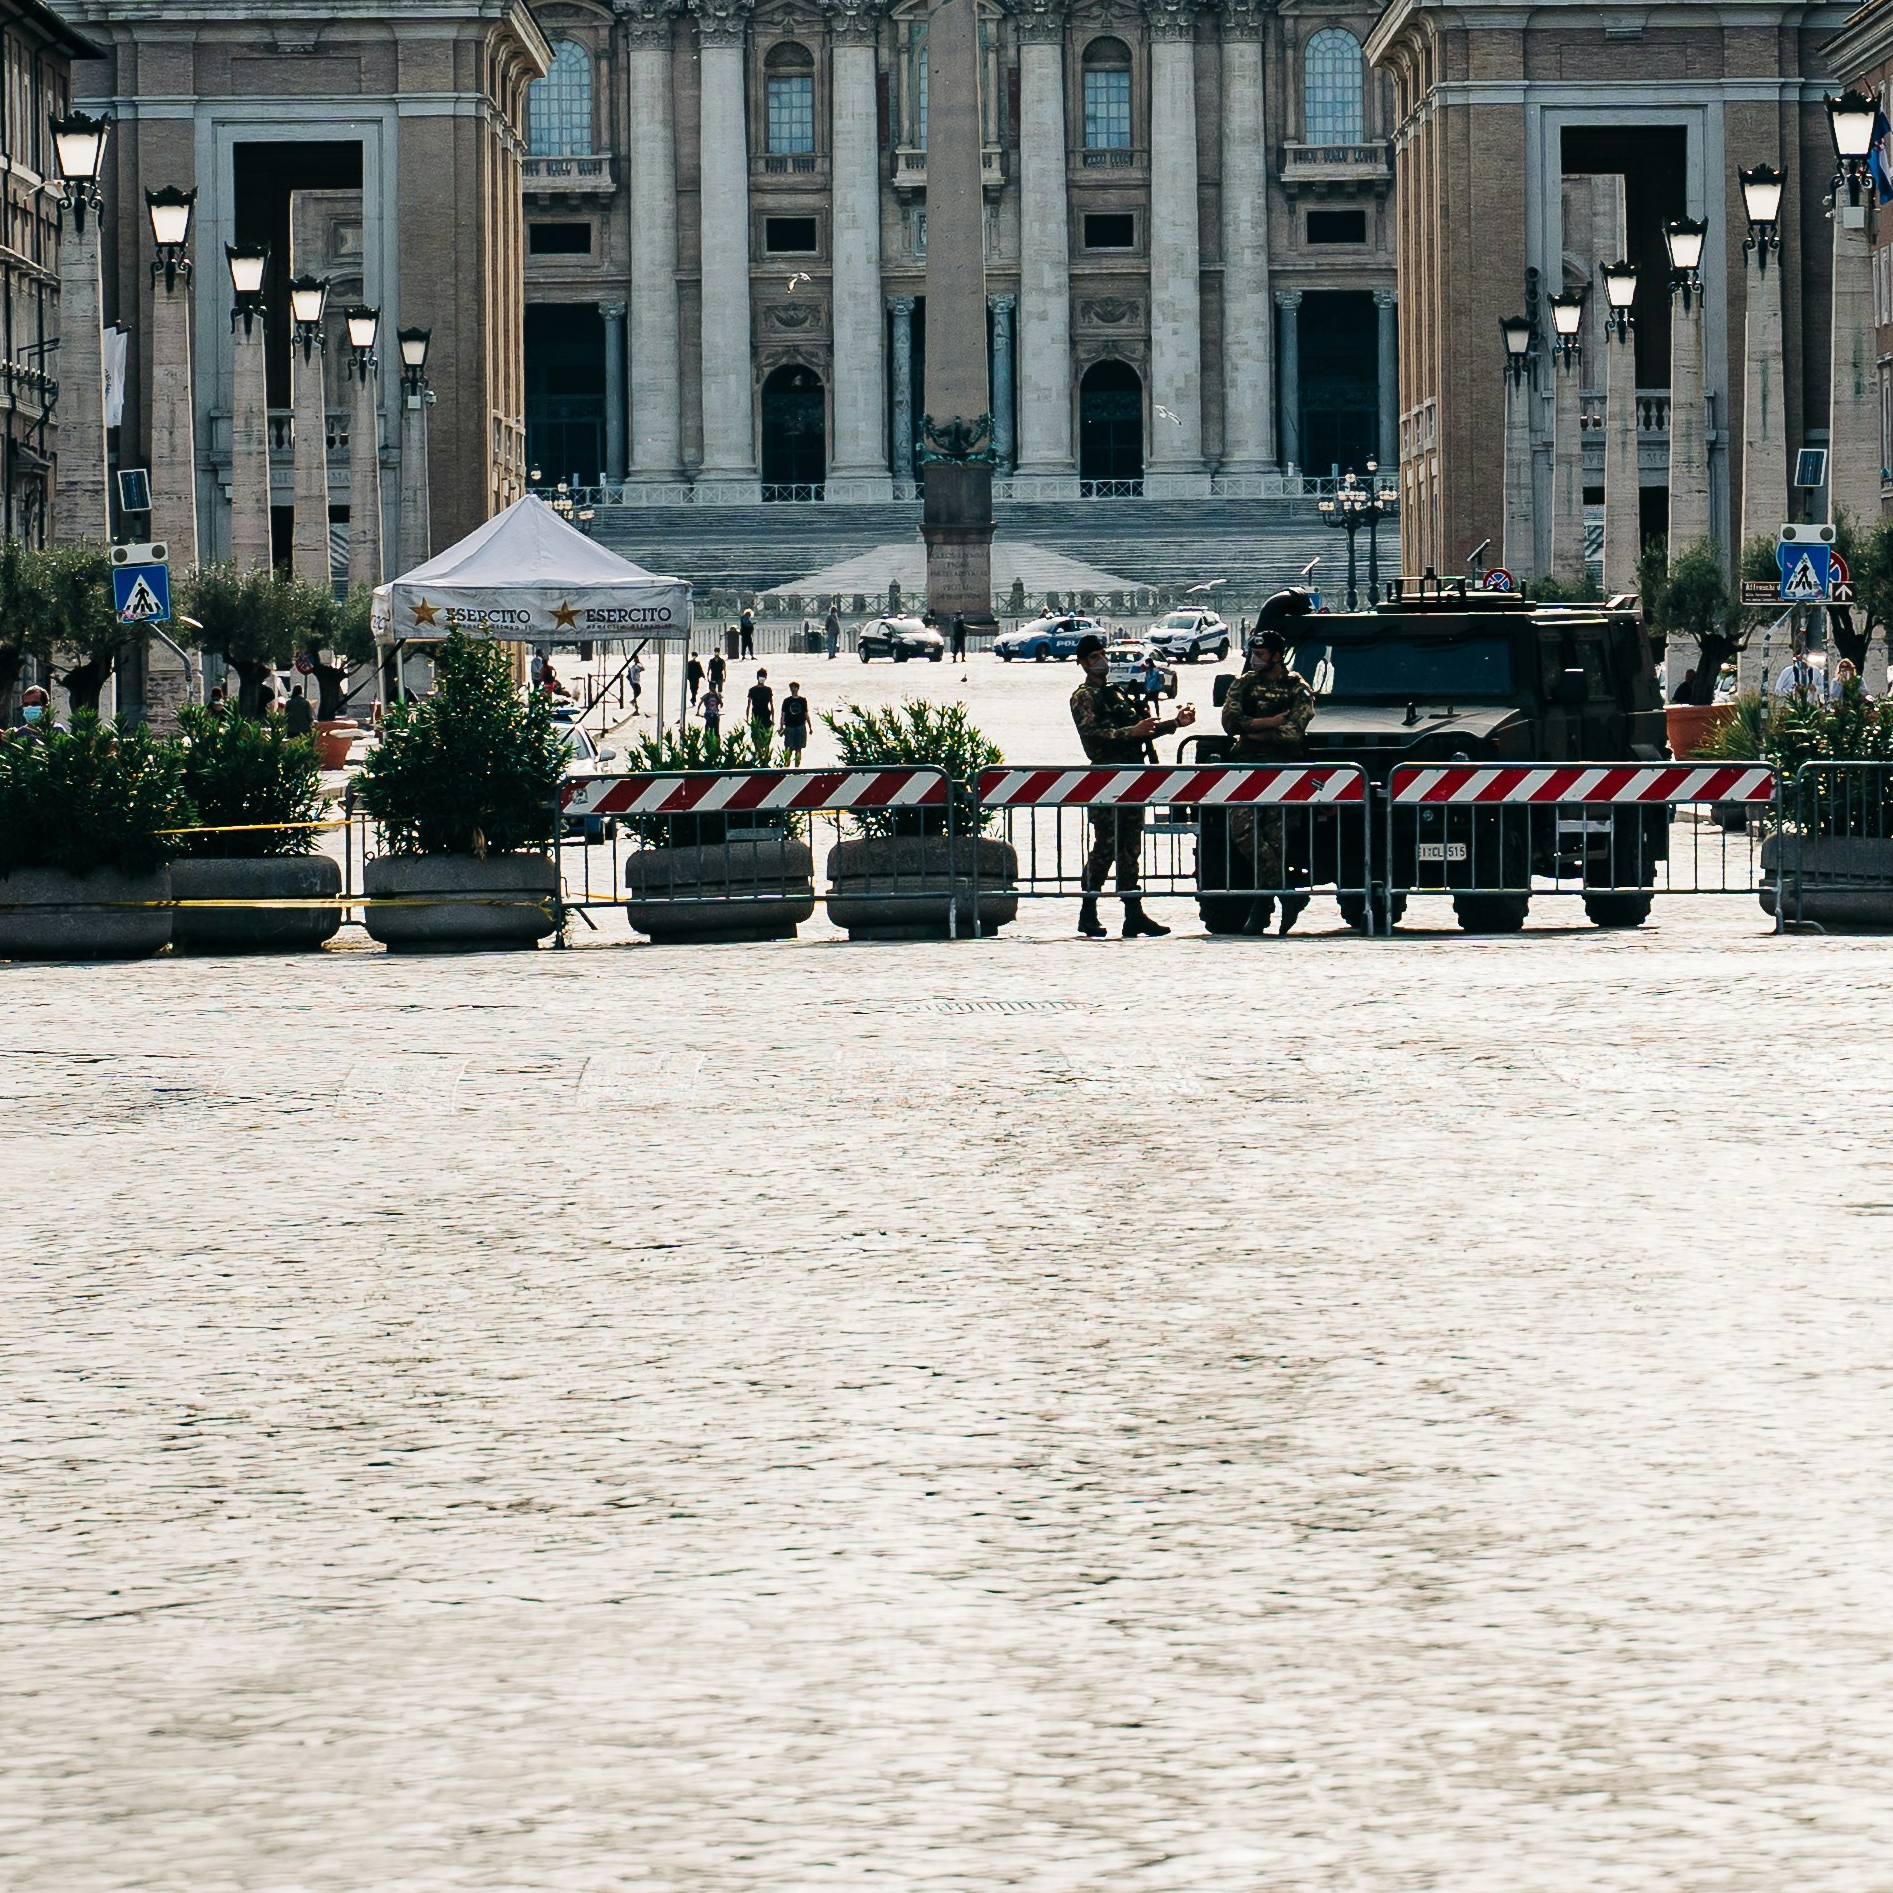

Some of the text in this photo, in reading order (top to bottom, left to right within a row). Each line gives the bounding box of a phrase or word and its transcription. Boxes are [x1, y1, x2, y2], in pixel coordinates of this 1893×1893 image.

[445, 608, 530, 623] ESERCITO
[586, 607, 672, 622] ESERCITO
[1448, 846, 1466, 857] 515
